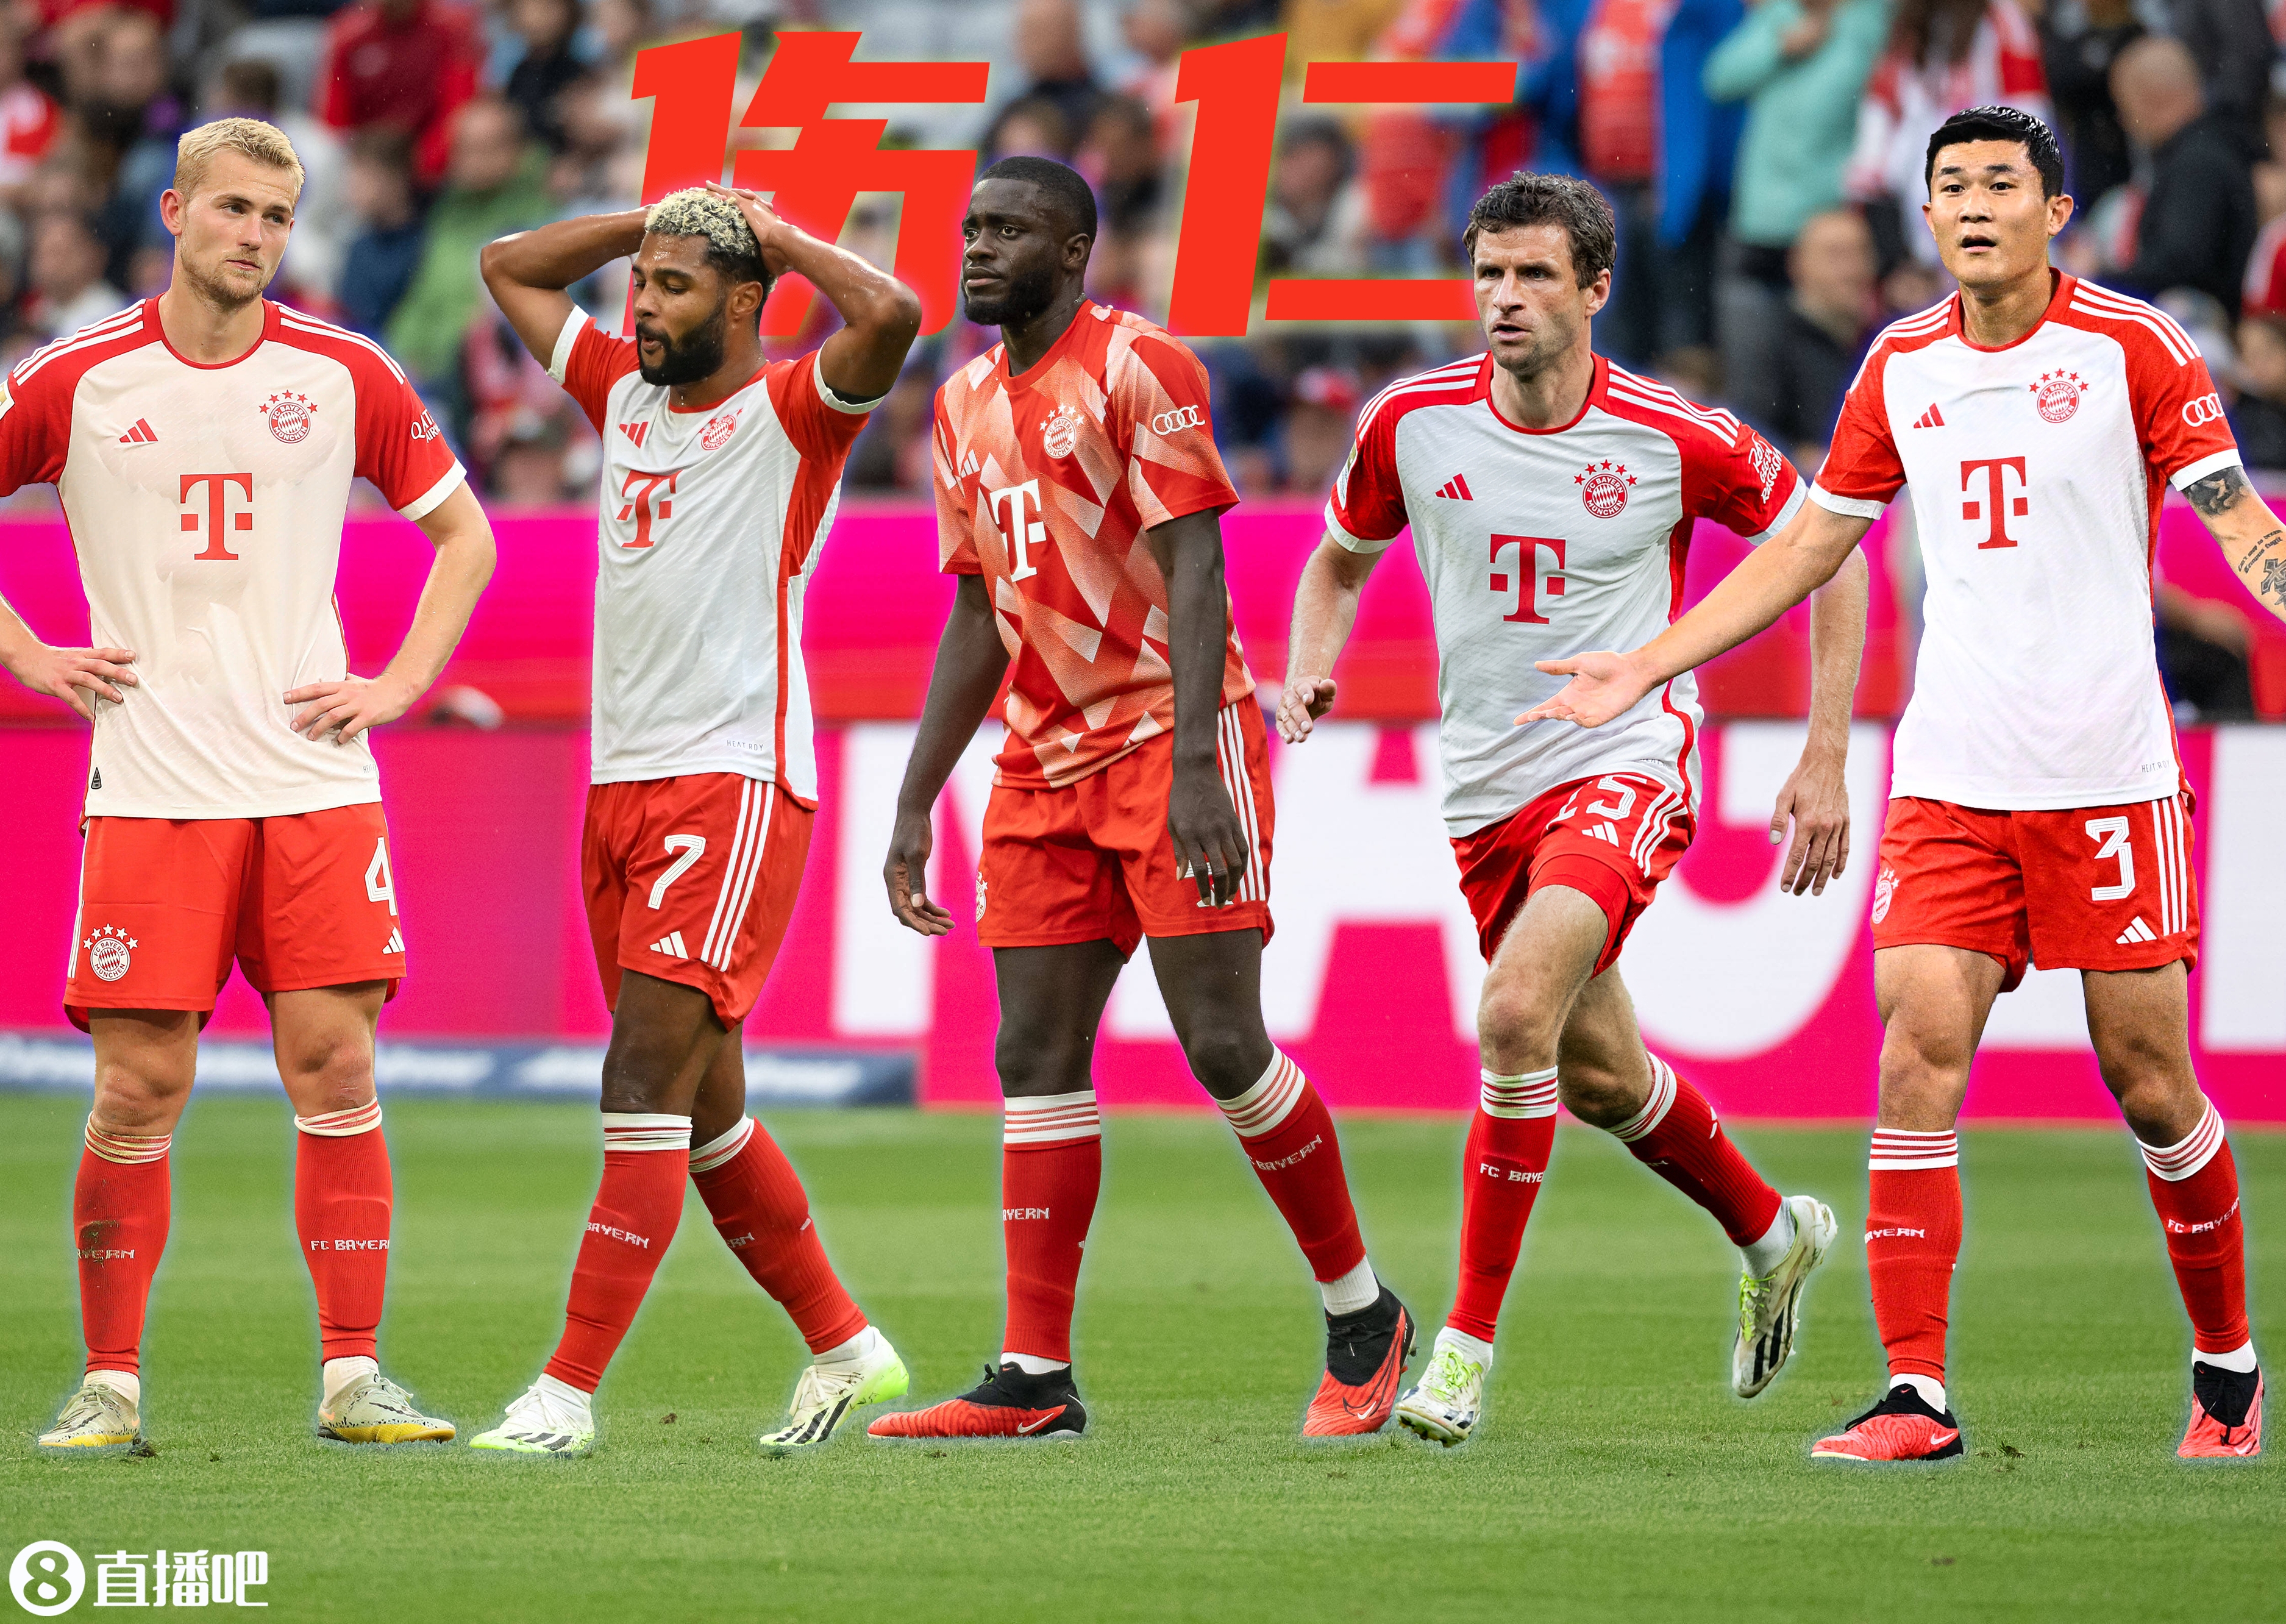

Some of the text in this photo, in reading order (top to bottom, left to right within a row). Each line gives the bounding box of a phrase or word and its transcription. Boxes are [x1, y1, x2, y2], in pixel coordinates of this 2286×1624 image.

[2041, 383, 2076, 400] FC BAYERN
[272, 405, 307, 420] FC BAYERN
[411, 409, 434, 439] QAT
[1054, 420, 1072, 433] BAYERN
[1587, 477, 1623, 493] FC BAYERN
[2085, 816, 2135, 901] 3
[365, 837, 397, 916] 4
[647, 834, 707, 910] 7
[94, 941, 125, 956] FC BAYERN
[1480, 1163, 1500, 1178] FC
[2168, 1219, 2184, 1233] FC
[310, 1239, 390, 1250] FC BAYER
